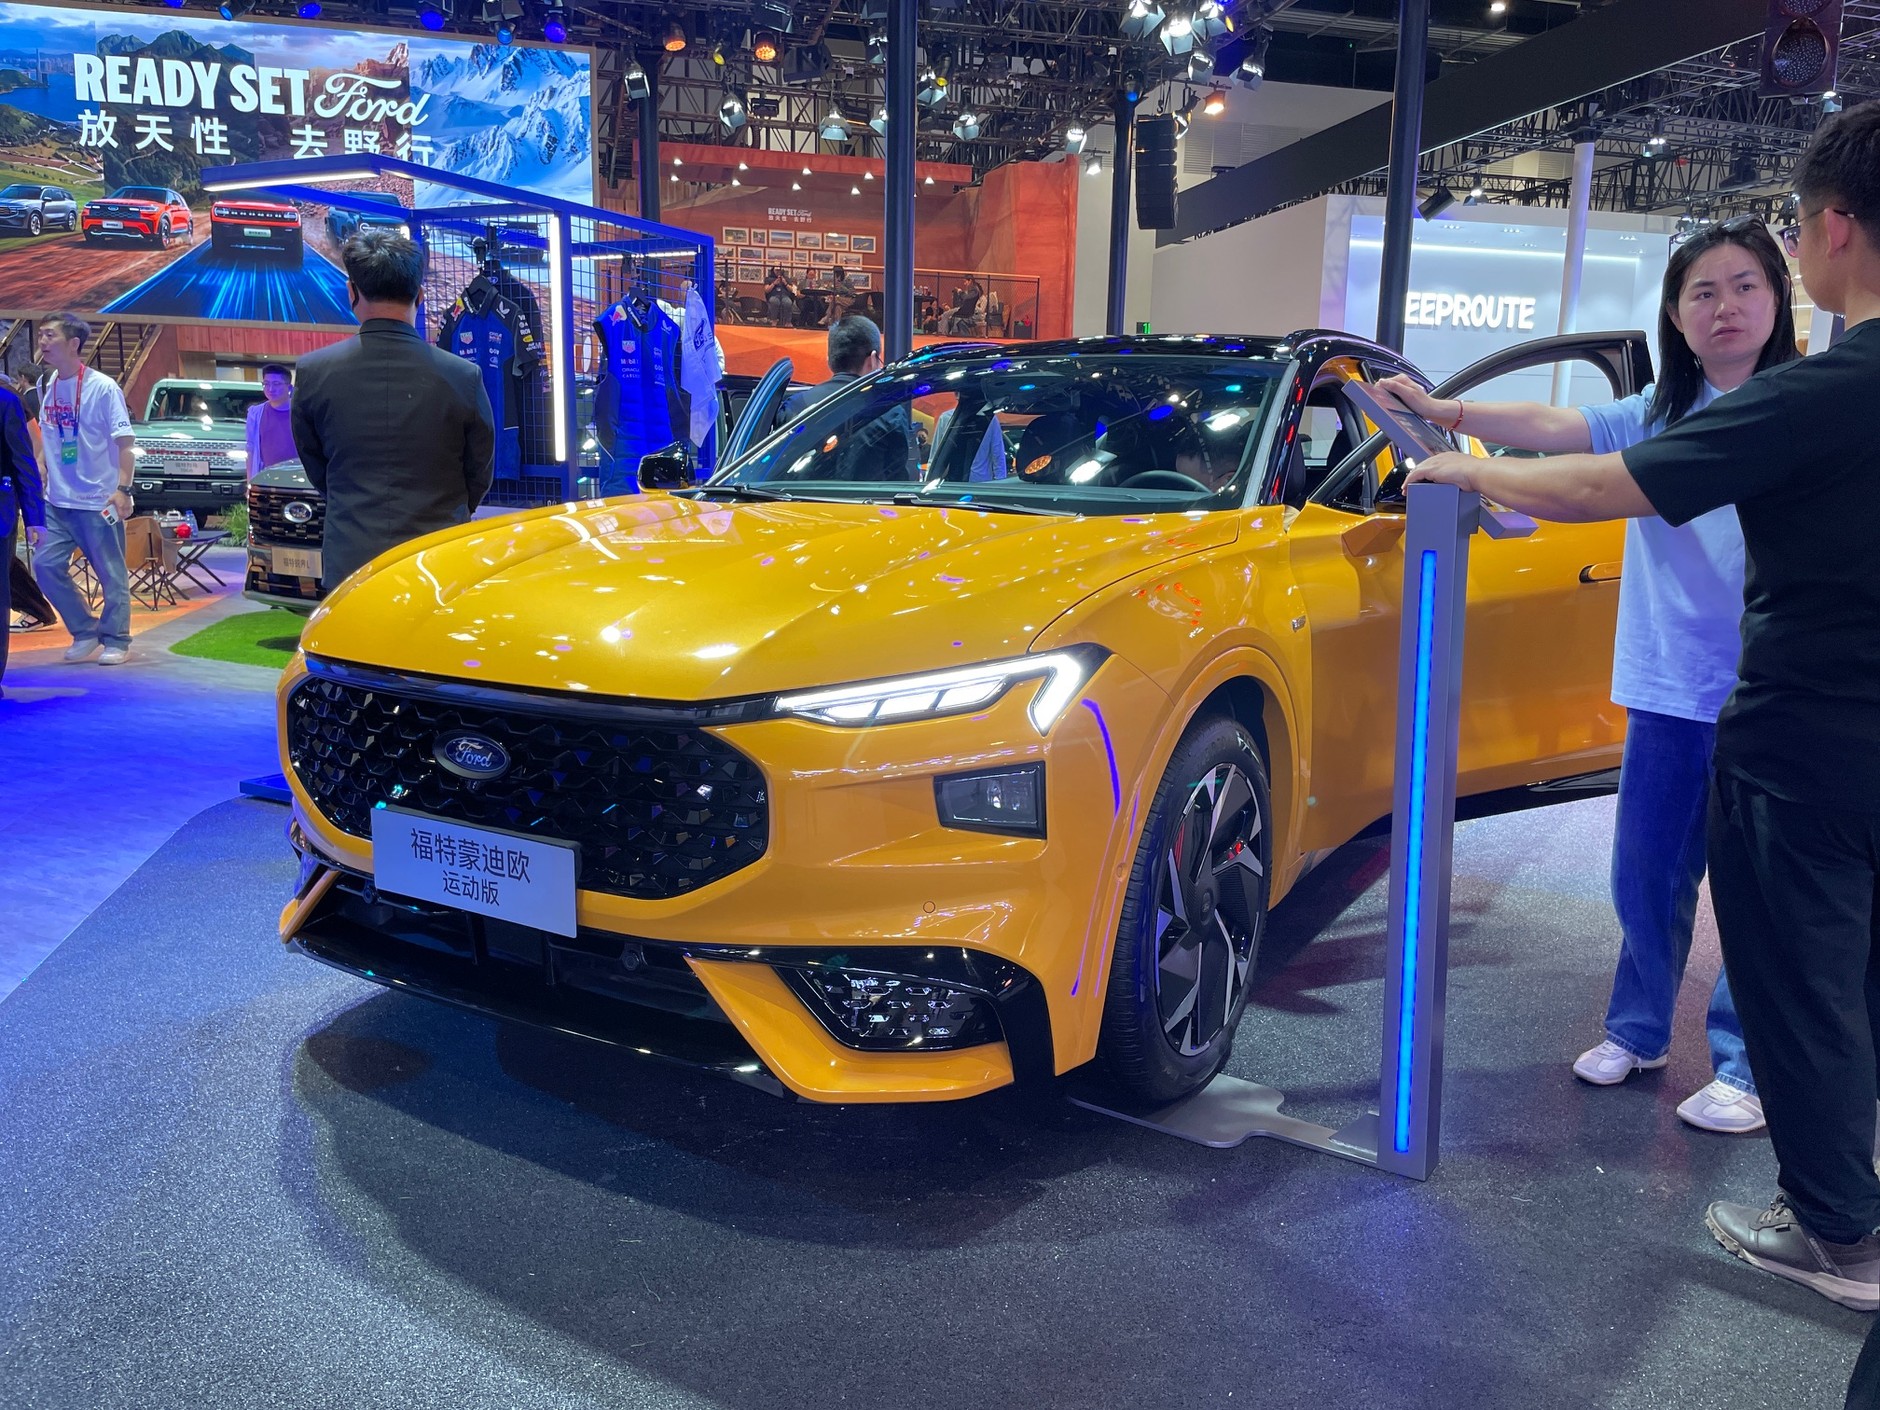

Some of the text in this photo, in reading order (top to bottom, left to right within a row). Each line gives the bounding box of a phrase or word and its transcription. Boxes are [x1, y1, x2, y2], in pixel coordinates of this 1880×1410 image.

[74, 53, 431, 126] READY SET Ford
[78, 109, 230, 155] 放天性
[1405, 291, 1536, 329] EEPROUTE
[455, 740, 492, 767] Ford
[411, 828, 531, 884] 福特蒙迪欧
[442, 870, 500, 906] 运动版
